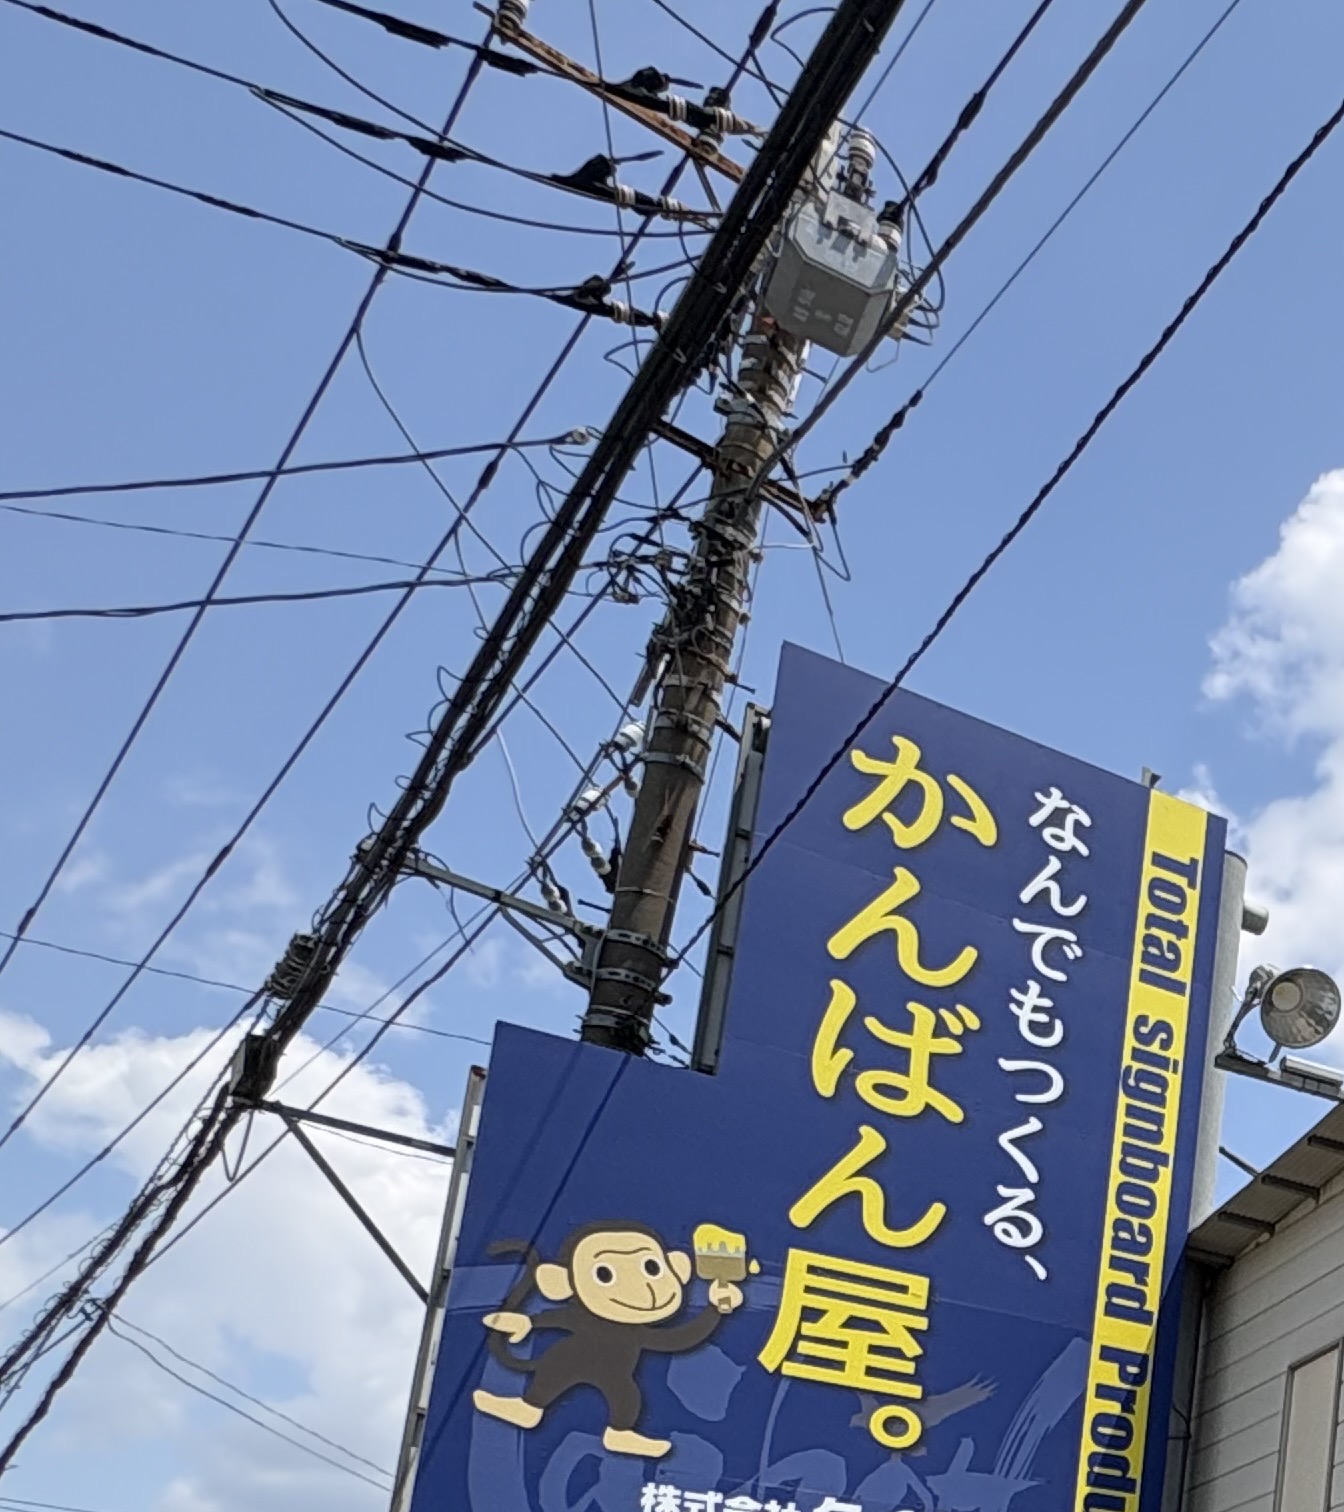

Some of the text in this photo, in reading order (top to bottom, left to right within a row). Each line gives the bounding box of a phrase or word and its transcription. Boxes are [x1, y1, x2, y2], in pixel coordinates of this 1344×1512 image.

[758, 734, 996, 1449] かんばん屋。
[983, 786, 1092, 1281] なんでもつくる、
[1138, 850, 1199, 997] Total
[1103, 1014, 1179, 1327] signboard
